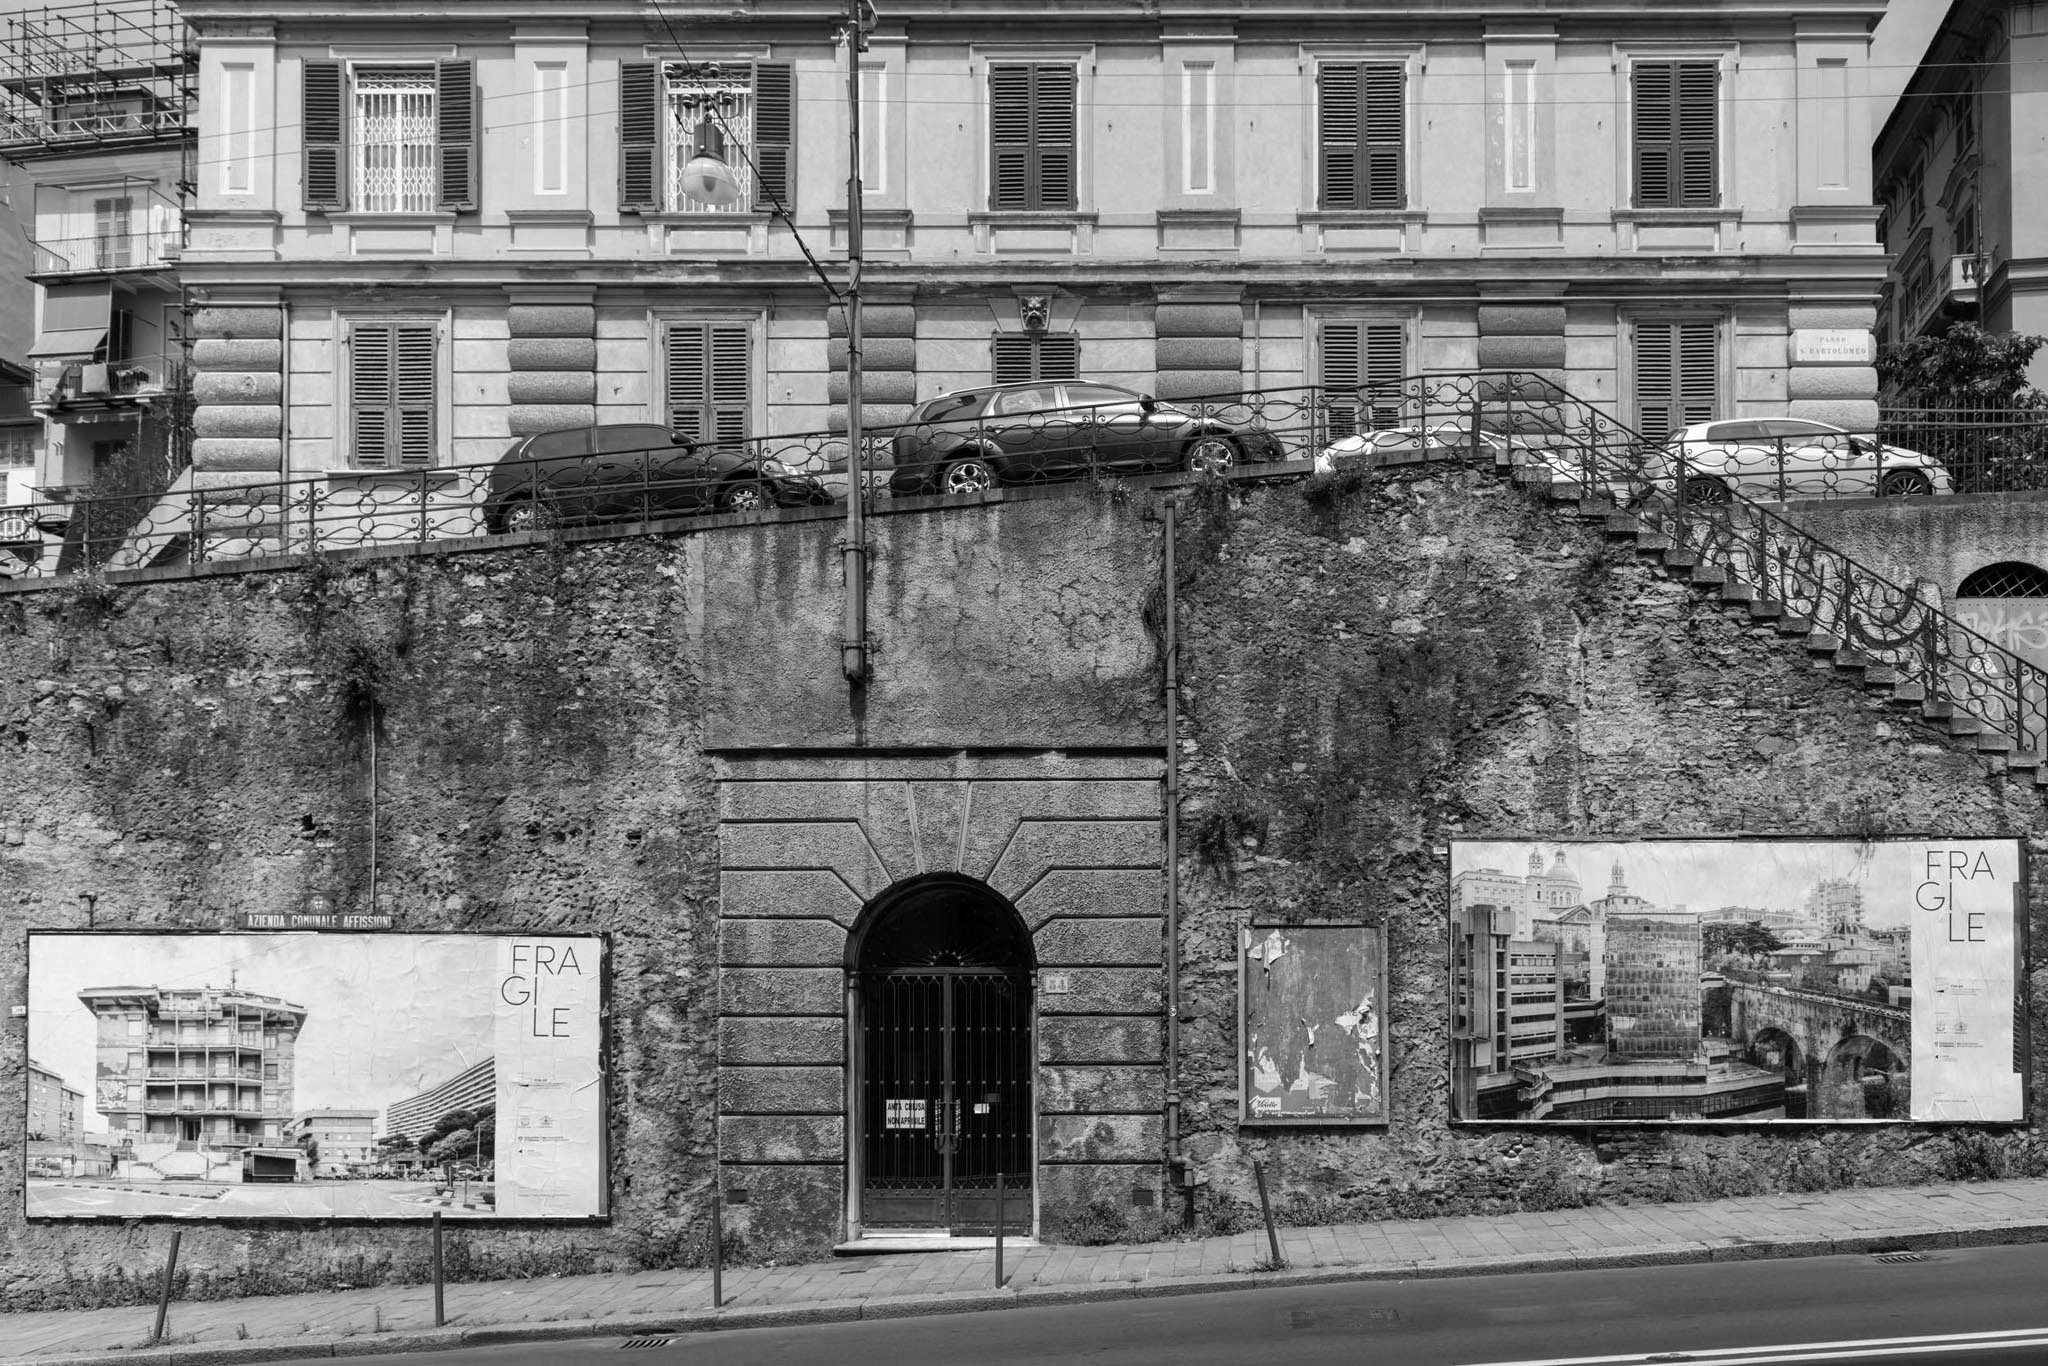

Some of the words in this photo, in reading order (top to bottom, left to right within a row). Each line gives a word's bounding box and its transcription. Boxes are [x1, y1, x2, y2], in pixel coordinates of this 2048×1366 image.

[1926, 850, 1995, 880] FRA
[1915, 881, 1953, 912] GI
[247, 914, 285, 928] AZIENDA
[291, 915, 337, 928] COMUNALE
[343, 915, 392, 928] AFFISSIONI
[1949, 912, 1986, 942] LE
[512, 945, 582, 975] FRA
[501, 976, 539, 1006] GI
[1049, 979, 1066, 990] 54
[533, 1007, 571, 1038] LE
